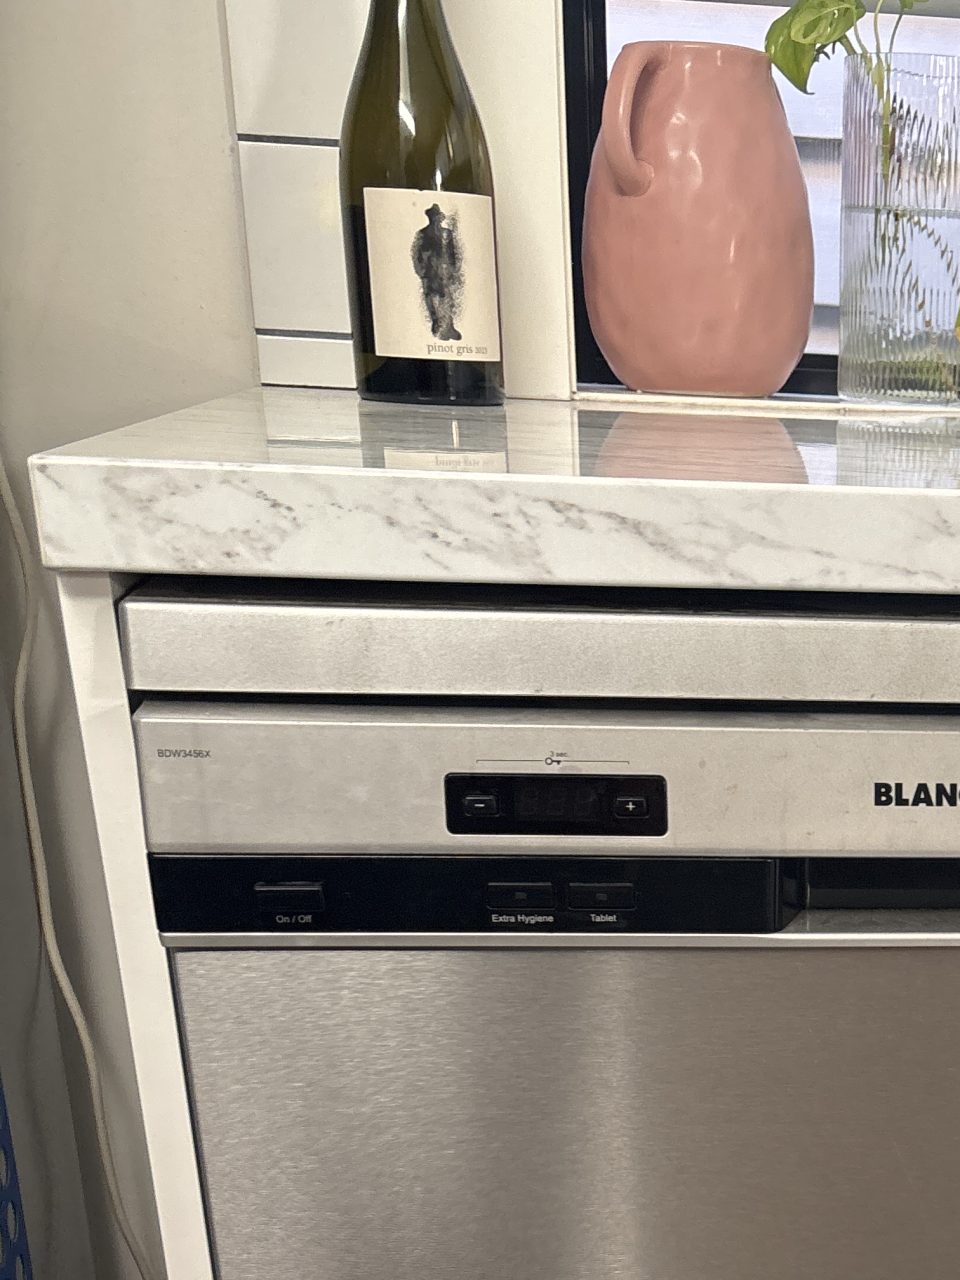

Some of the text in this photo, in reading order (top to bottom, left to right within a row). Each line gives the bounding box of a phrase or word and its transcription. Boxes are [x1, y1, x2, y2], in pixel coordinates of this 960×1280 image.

[427, 343, 454, 355] pinot
[456, 344, 473, 356] gris
[275, 914, 291, 924] On
[297, 914, 313, 924] Off
[491, 914, 554, 925] Extra Hygiene
[590, 913, 617, 923] Tablet
